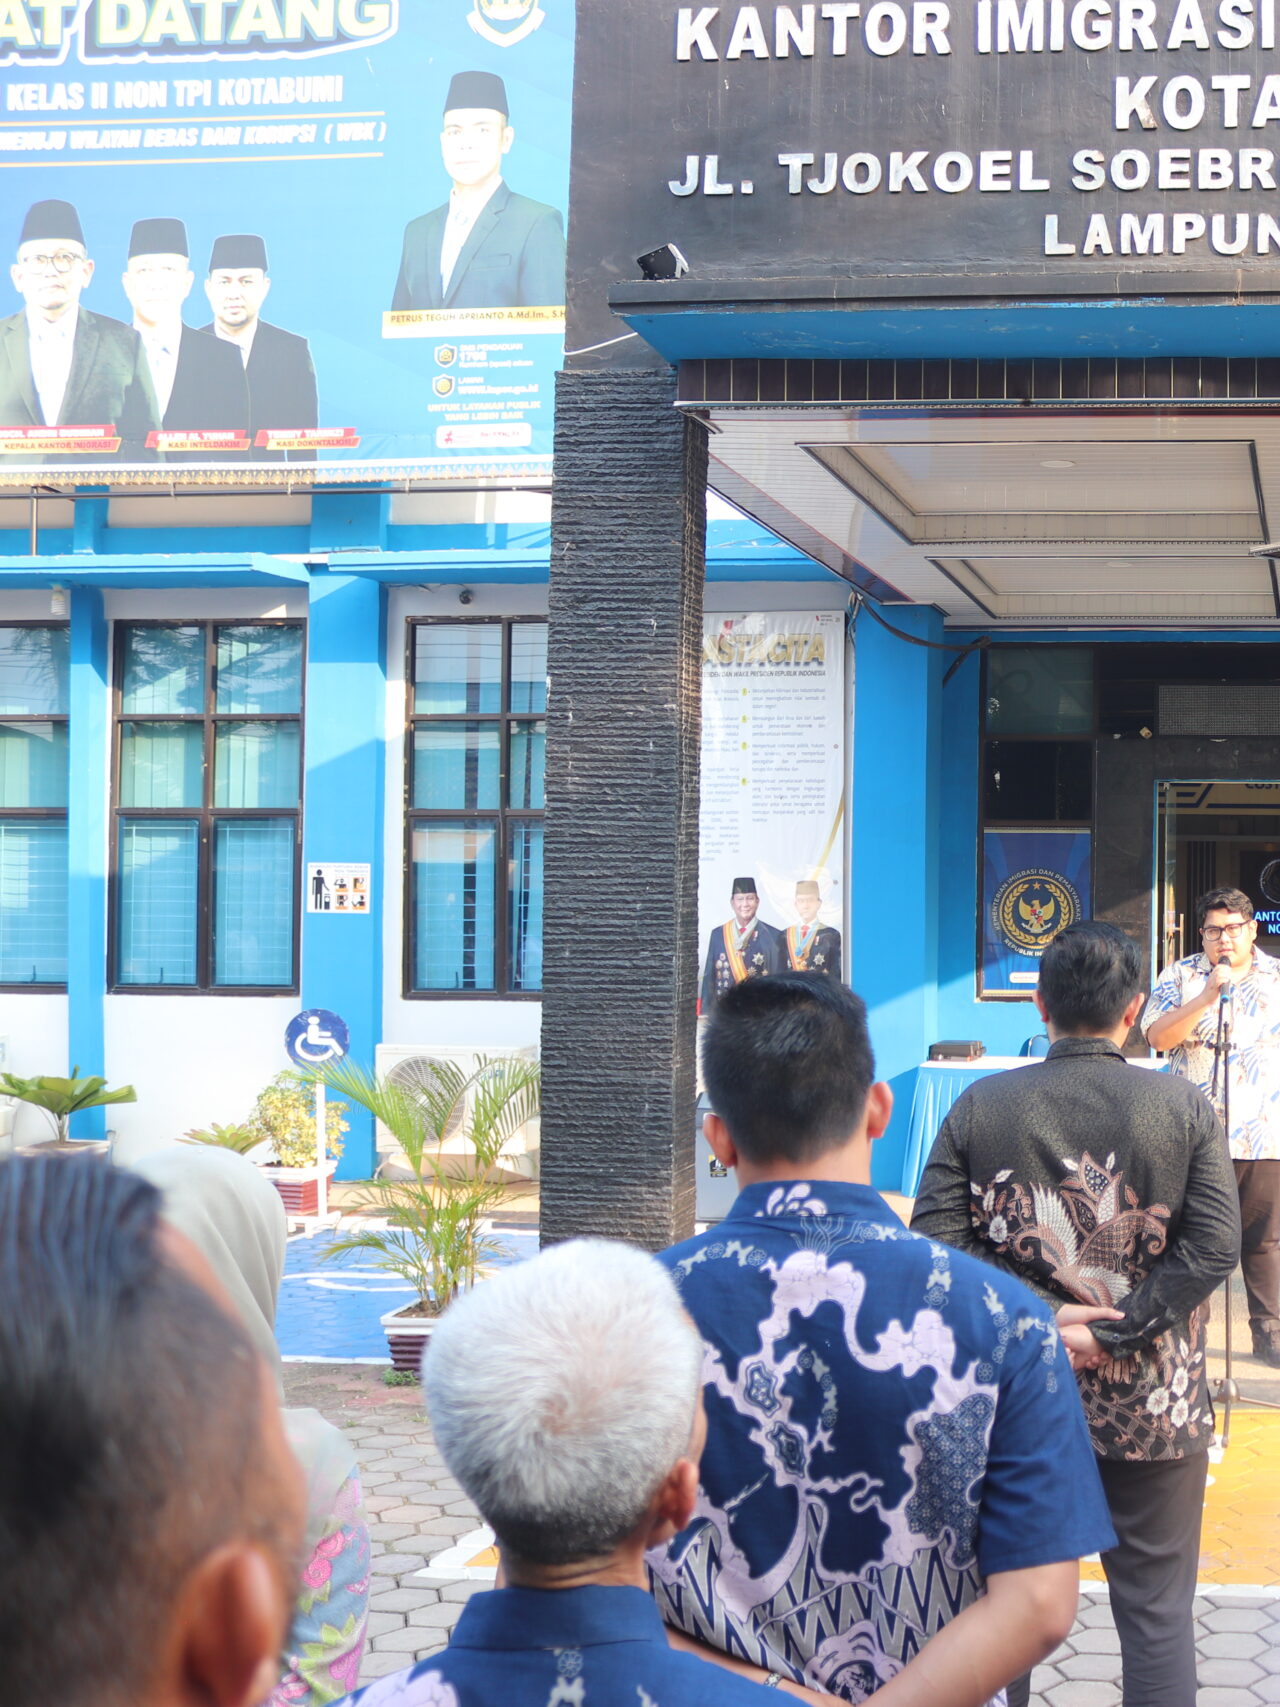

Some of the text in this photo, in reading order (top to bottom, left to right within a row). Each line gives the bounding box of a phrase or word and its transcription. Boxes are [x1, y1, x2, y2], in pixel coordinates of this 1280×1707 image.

[98, 0, 391, 45] DATANG
[675, 1, 953, 60] KANTOR
[976, 0, 1276, 53] IMIGRASI
[7, 75, 343, 111] KELAS II NON TPI KOTABUMI
[243, 124, 317, 144] KORUPSI
[668, 155, 754, 196] JL.
[778, 150, 1050, 195] TJOKOEL
[391, 313, 423, 323] PETRUS
[425, 312, 456, 322] TEGUH
[458, 311, 505, 321] APRIANTO
[4, 442, 35, 450] KEPALA
[38, 441, 71, 450] KANTOR
[168, 441, 188, 449] KASI
[798, 669, 826, 677] INDONESIA
[991, 867, 1082, 931] KEMENTERIAN IMIGRASI DAN PEMASYARAKAT
[1003, 937, 1034, 957] REPUBLIK
